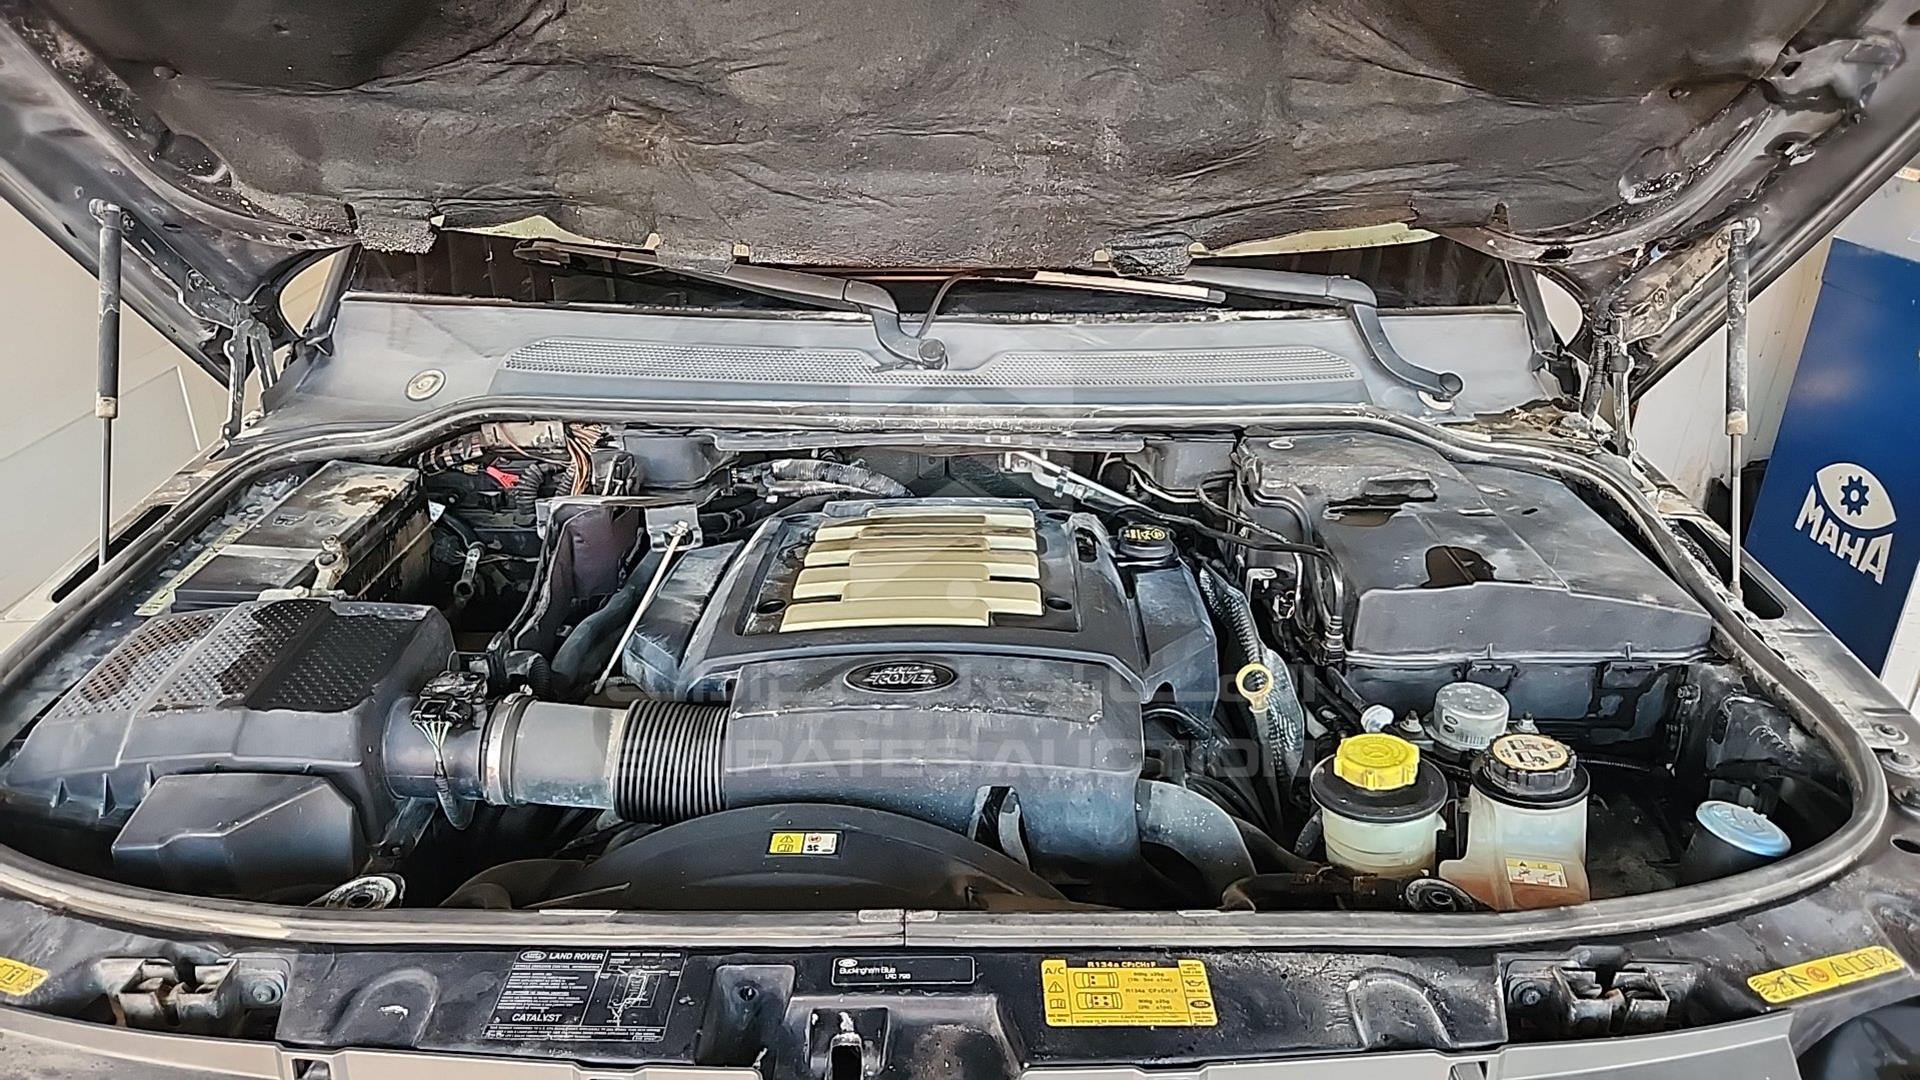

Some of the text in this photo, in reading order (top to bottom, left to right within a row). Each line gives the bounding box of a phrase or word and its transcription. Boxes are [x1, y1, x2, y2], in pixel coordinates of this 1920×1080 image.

[1795, 484, 1893, 585] MAHA
[877, 673, 937, 685] ROVER
[549, 952, 573, 960] LAND
[574, 952, 604, 961] ROVER
[839, 966, 896, 975] Buckingham Blue
[1044, 967, 1065, 975] A/C
[511, 1013, 563, 1022] CATALYST
